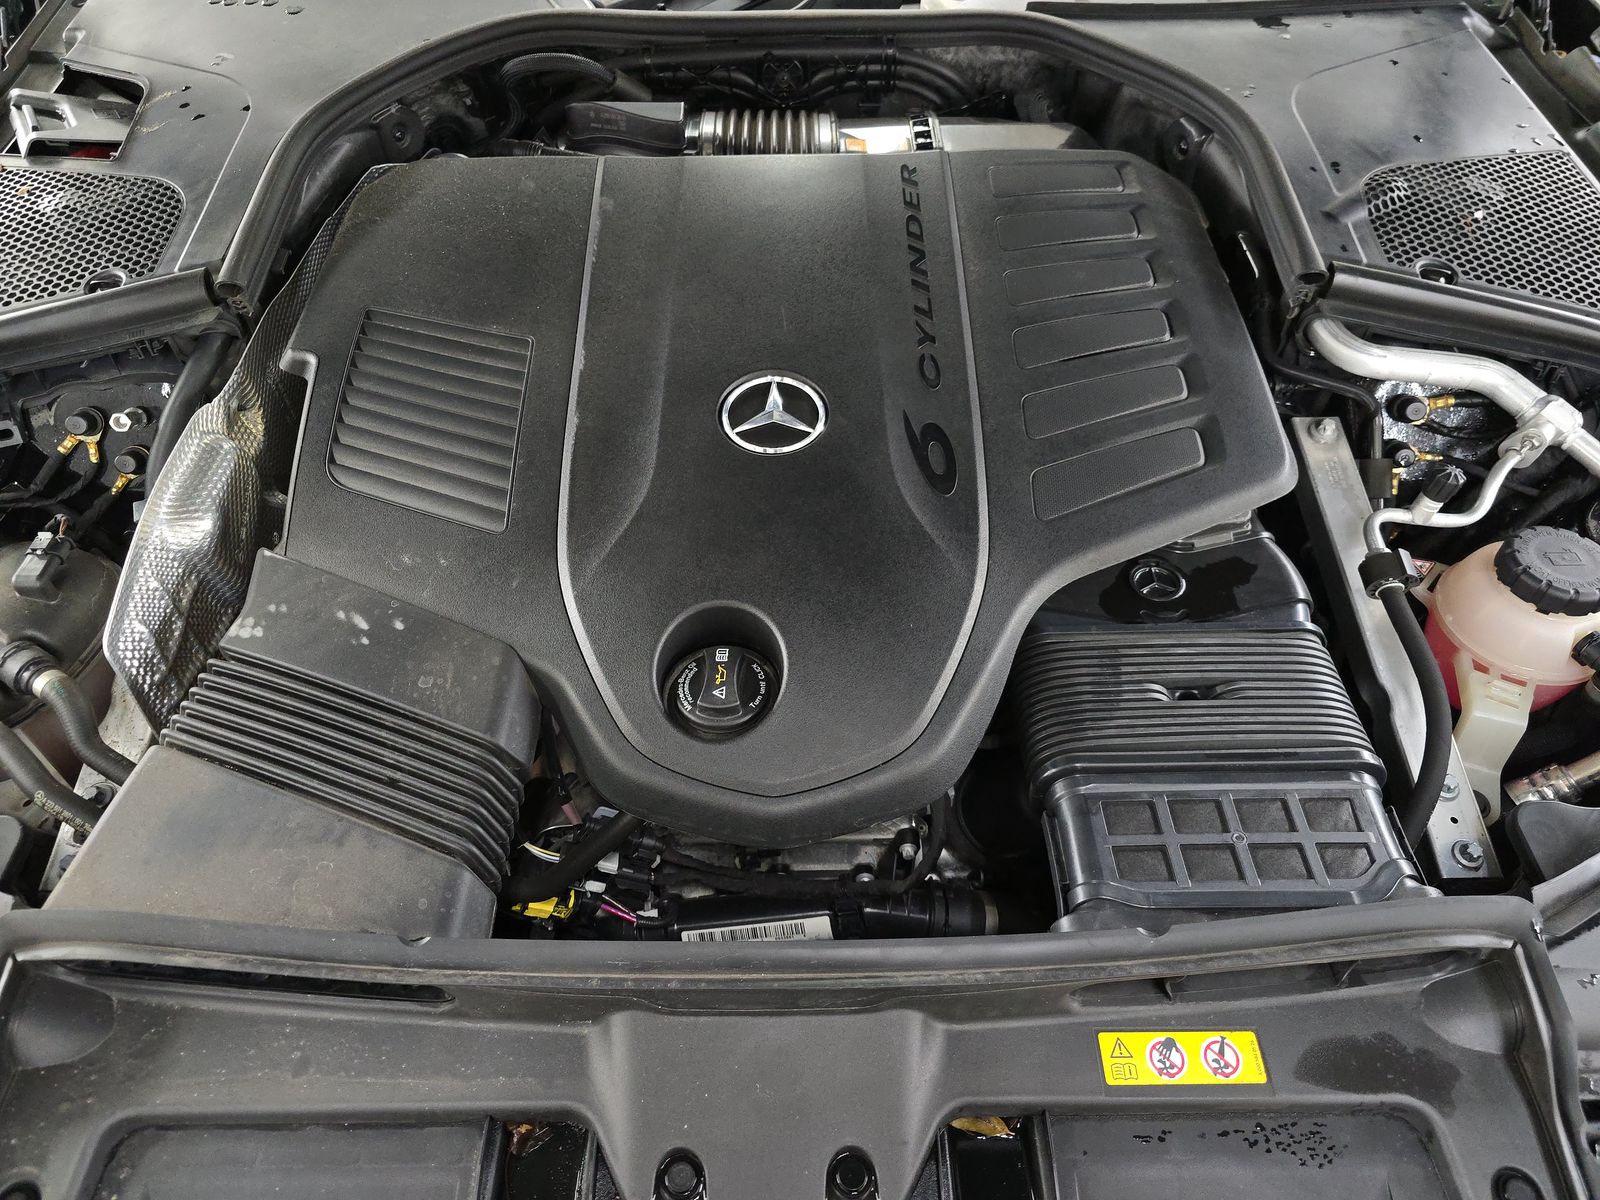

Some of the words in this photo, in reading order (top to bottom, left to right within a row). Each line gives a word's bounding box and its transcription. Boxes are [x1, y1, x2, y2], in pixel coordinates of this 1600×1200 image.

[900, 163, 942, 391] CYLINDER
[903, 409, 959, 497] 6
[677, 668, 693, 712] Mercedes-Benz
[683, 667, 698, 703] recommended
[752, 663, 765, 680] CLICK
[749, 695, 763, 708] Turn
